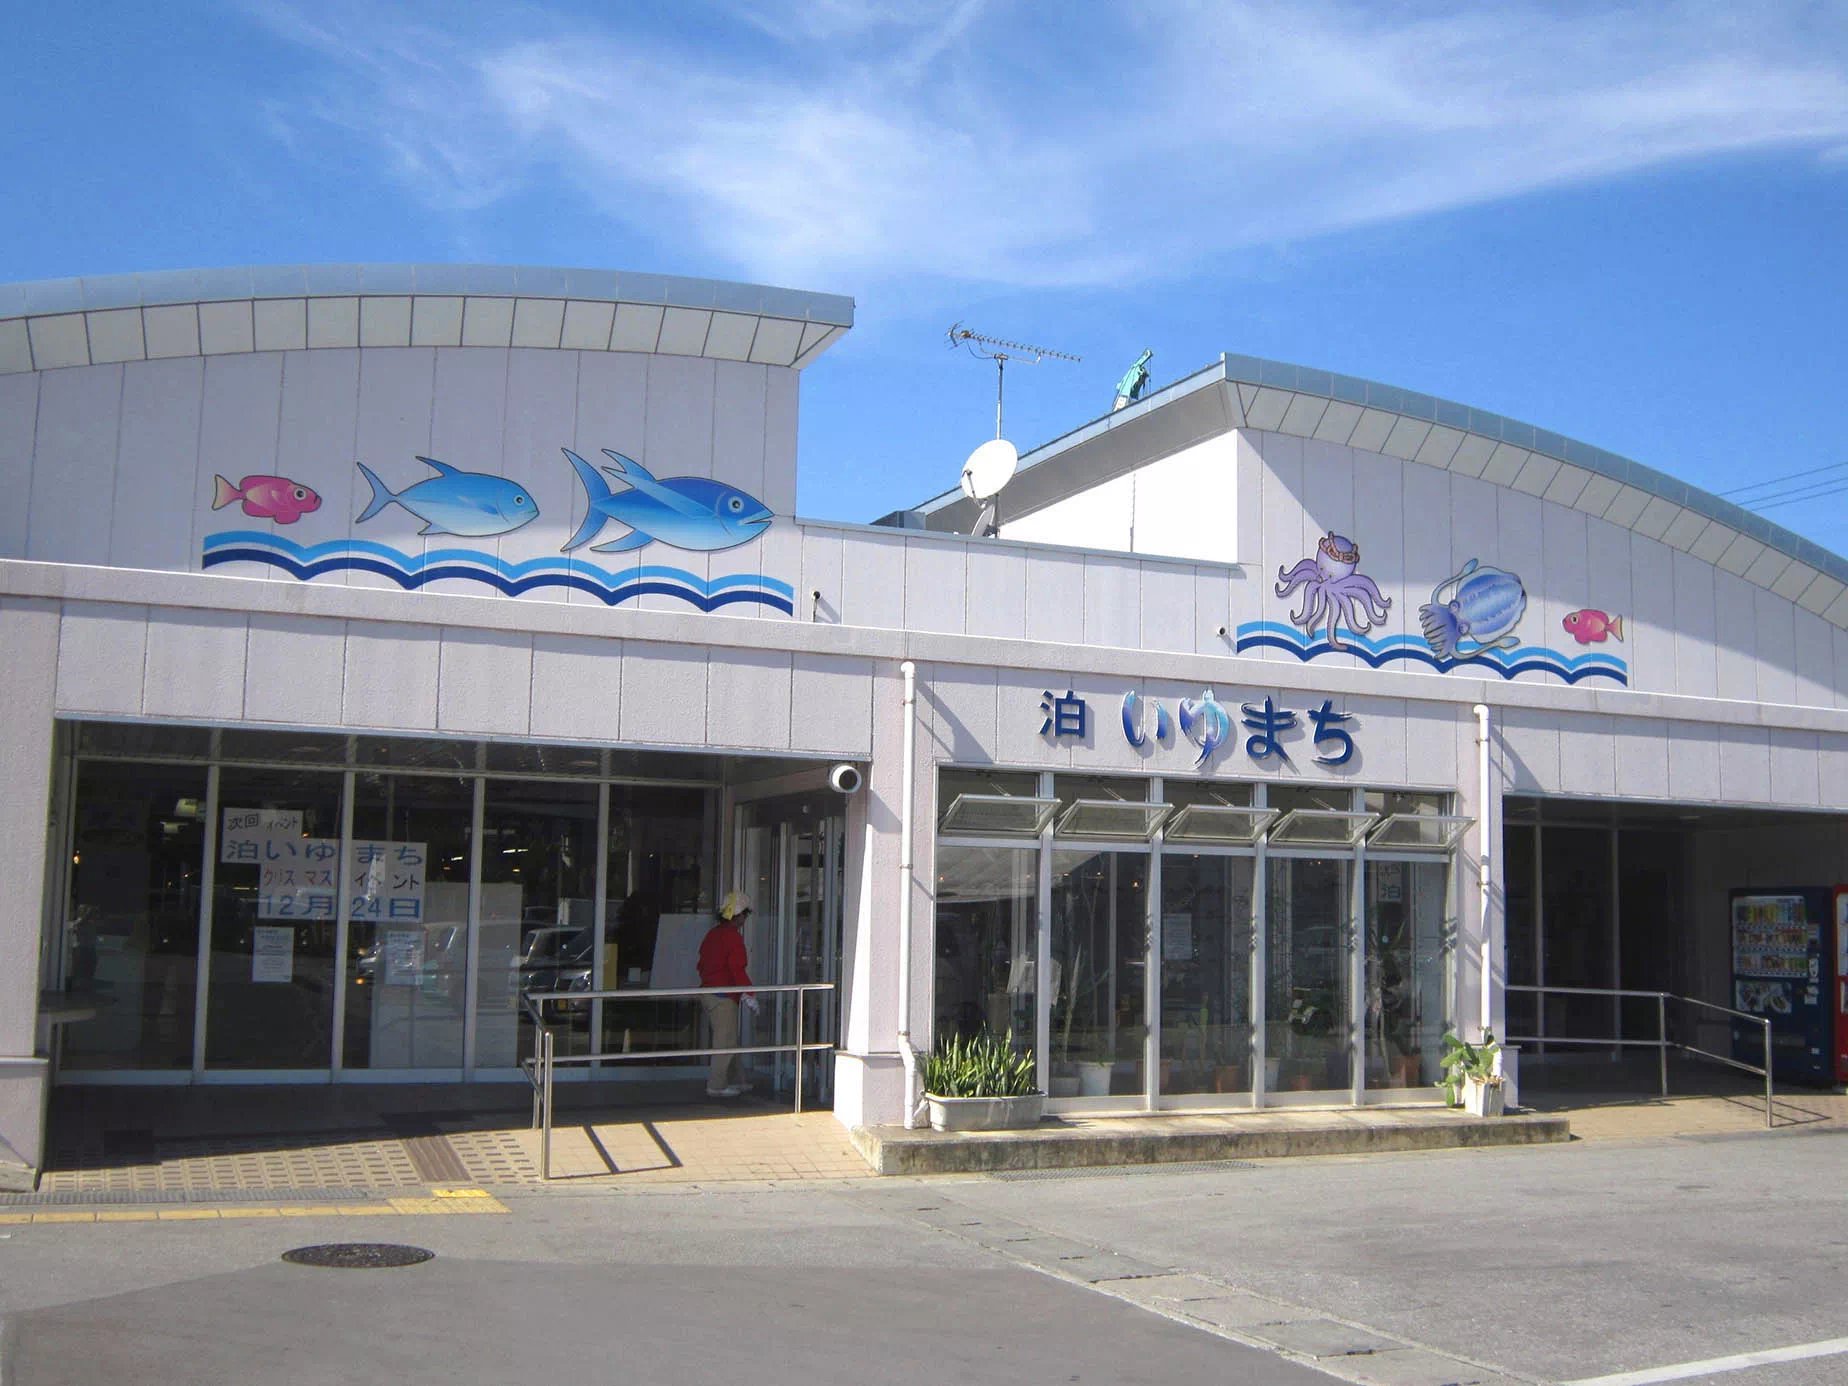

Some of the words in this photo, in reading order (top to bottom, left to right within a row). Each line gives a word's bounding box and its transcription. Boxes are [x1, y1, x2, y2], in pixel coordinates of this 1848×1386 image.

[1039, 687, 1354, 774] 泊いゆまち
[227, 839, 423, 866] 泊いゆまち
[263, 895, 420, 919] 12月24日
